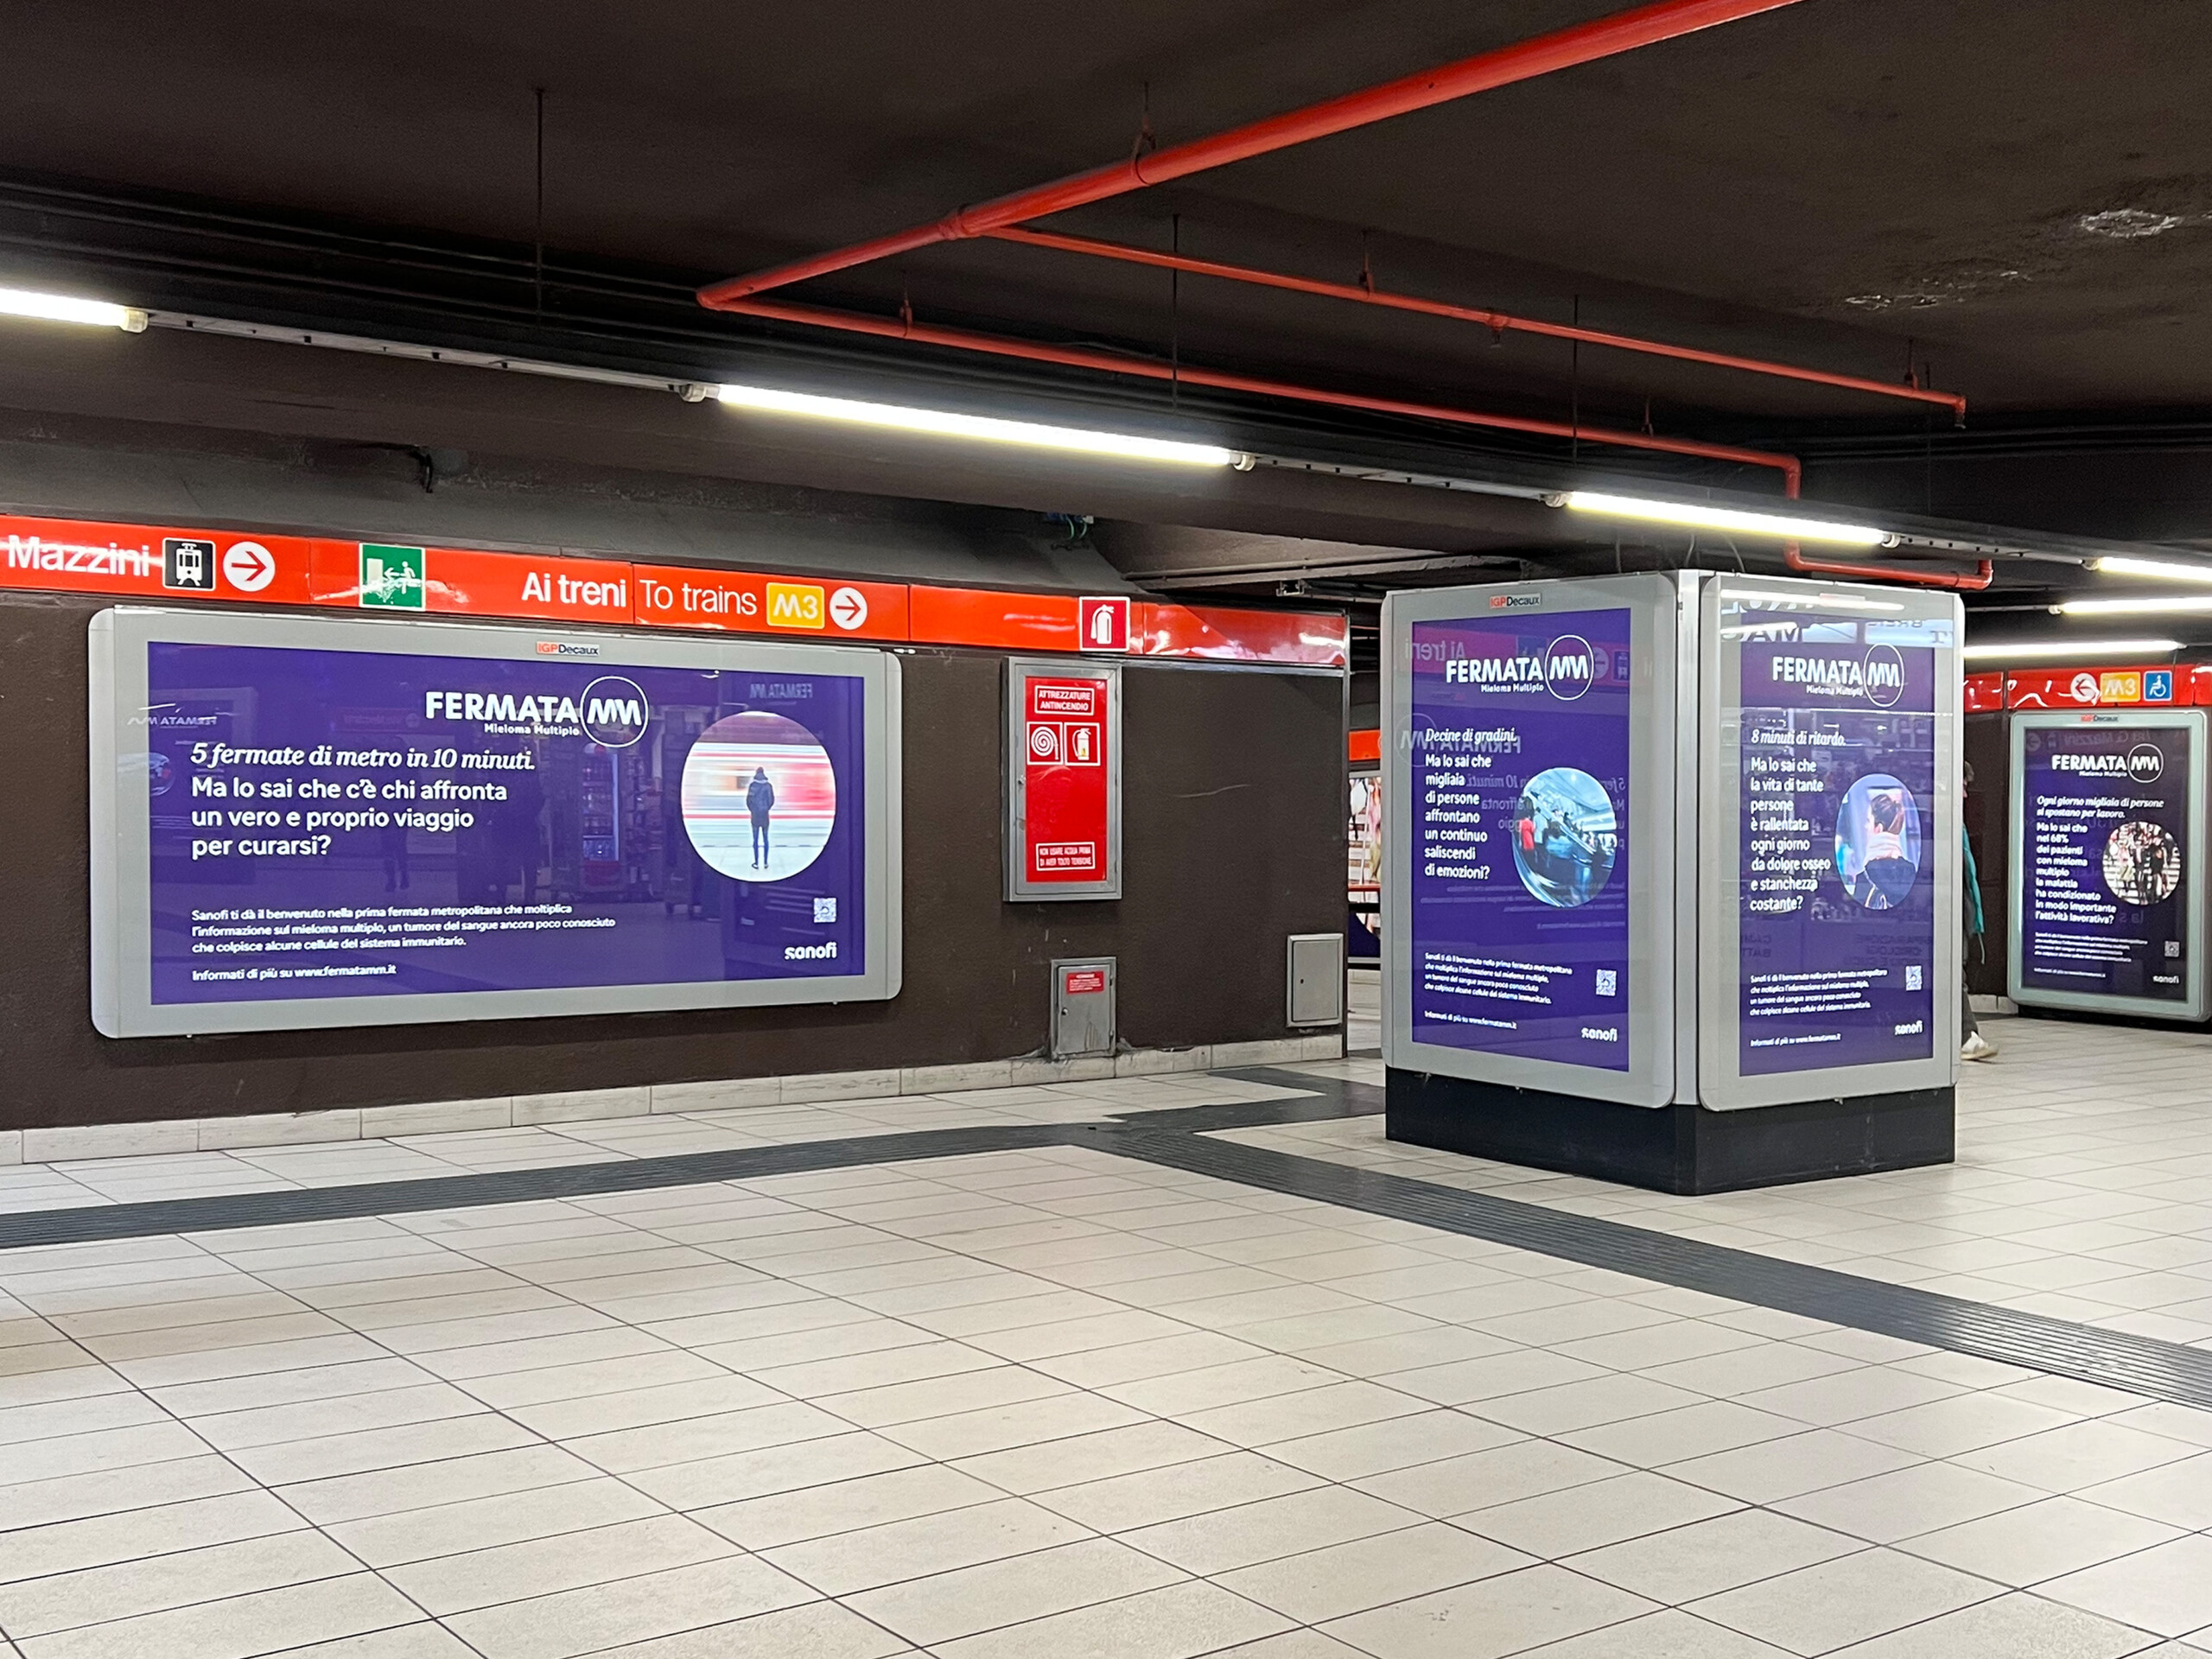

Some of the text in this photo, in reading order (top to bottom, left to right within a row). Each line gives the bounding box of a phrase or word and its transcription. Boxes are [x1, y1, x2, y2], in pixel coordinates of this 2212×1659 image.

[8, 535, 150, 577] Mazzini
[521, 571, 626, 608] Ai treni
[640, 579, 757, 616] To trains
[1490, 594, 1540, 607] IGPDecaux
[773, 594, 819, 620] M3
[537, 642, 600, 656] IGPDecaux
[1446, 658, 1544, 683] FERMATA
[1772, 656, 1863, 684] FERMATA
[1481, 683, 1544, 693] Mieloma Multiplo
[2105, 679, 2136, 696] M3
[1039, 690, 1091, 701] ATTREZZATURE
[425, 691, 580, 724] FERMATA
[1039, 701, 1089, 711] ANTINCENDIO
[484, 723, 580, 737] Mieloma Multiplo
[1425, 728, 1516, 744] Decine di gradini.
[1751, 729, 1846, 746] 8 minuti di ritardo.
[190, 743, 536, 770] 5 fermate di metro in 10 minuti.
[1426, 754, 1492, 767] Ma lo sai che
[2051, 754, 2126, 771] FERMATA
[1751, 757, 1816, 772] Ma lo sai che
[1426, 772, 1465, 788] migliaia
[1751, 778, 1824, 791] la vita di tante
[192, 776, 507, 800] Ma lo sai che c'è chi affronta
[1426, 791, 1480, 809] di persone
[1751, 799, 1794, 814] persone
[2037, 796, 2164, 810] Ogni giorno migliaia di persone
[191, 806, 474, 832] un vero e proprio viaggio
[1425, 810, 1480, 823] affrontano
[1751, 817, 1808, 831] è rallentata
[1425, 829, 1488, 842] un continuo
[2037, 823, 2088, 833] Ma lo sai che
[192, 834, 332, 861] per curarsi?
[1425, 845, 1476, 860] saliscendi
[1751, 837, 1810, 855] ogni giorno
[2037, 845, 2083, 855] dei pazienti
[1751, 857, 1831, 871] da dolore osseo
[2053, 856, 2088, 866] mieloma
[1425, 865, 1490, 880] di emozioni?
[2036, 868, 2069, 878] multiplo
[1751, 878, 1818, 892] e stanchezza
[2036, 878, 2078, 888] la malattia
[2036, 888, 2101, 900] ha condizionato
[1750, 896, 1803, 912] costante?
[2036, 900, 2117, 913] in modo importante
[191, 903, 572, 921] Sanofi ti dà il benvenuto nella prima fermata metropolitana che moltiplica
[2036, 911, 2114, 925] l'attività lavorativa?
[192, 917, 616, 938] l'informazione sul mieloma multiplo, un tumore del sangue ancora poco conosciuto
[192, 936, 467, 954] che colpisce alcune cellule del sistema immunitario.
[785, 942, 836, 959] sanofi
[192, 969, 245, 982] Informati
[246, 968, 257, 979] di
[259, 967, 277, 981] più
[279, 969, 293, 978] su
[2152, 975, 2180, 984] sanofi
[1581, 1027, 1618, 1042] sanofi
[1895, 1020, 1923, 1035] sanofi
